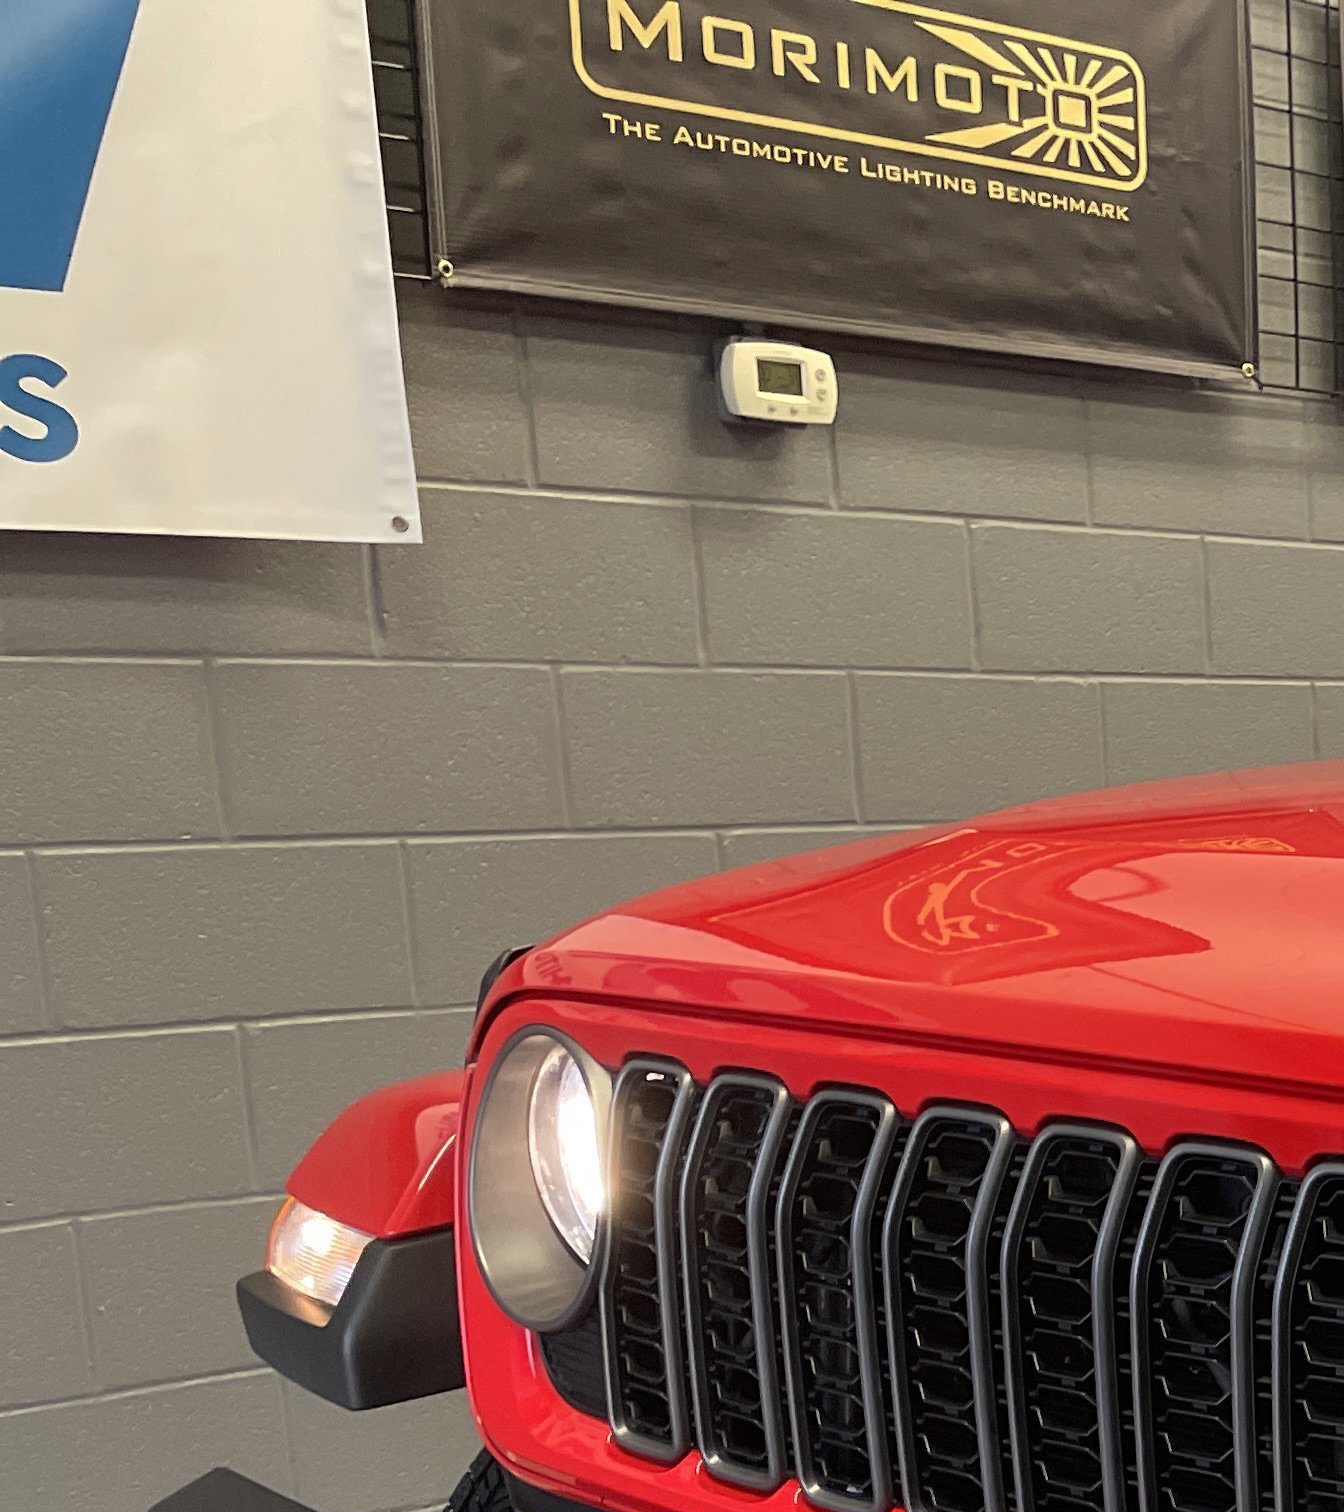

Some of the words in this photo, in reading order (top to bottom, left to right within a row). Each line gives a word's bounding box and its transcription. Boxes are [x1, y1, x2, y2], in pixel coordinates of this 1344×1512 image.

[607, 0, 1098, 137] MORIMOTO
[602, 112, 662, 142] THE
[673, 125, 849, 174] AUTOMOTIVE
[860, 157, 977, 197] LIGHTING
[987, 180, 1130, 222] BENCHMARK
